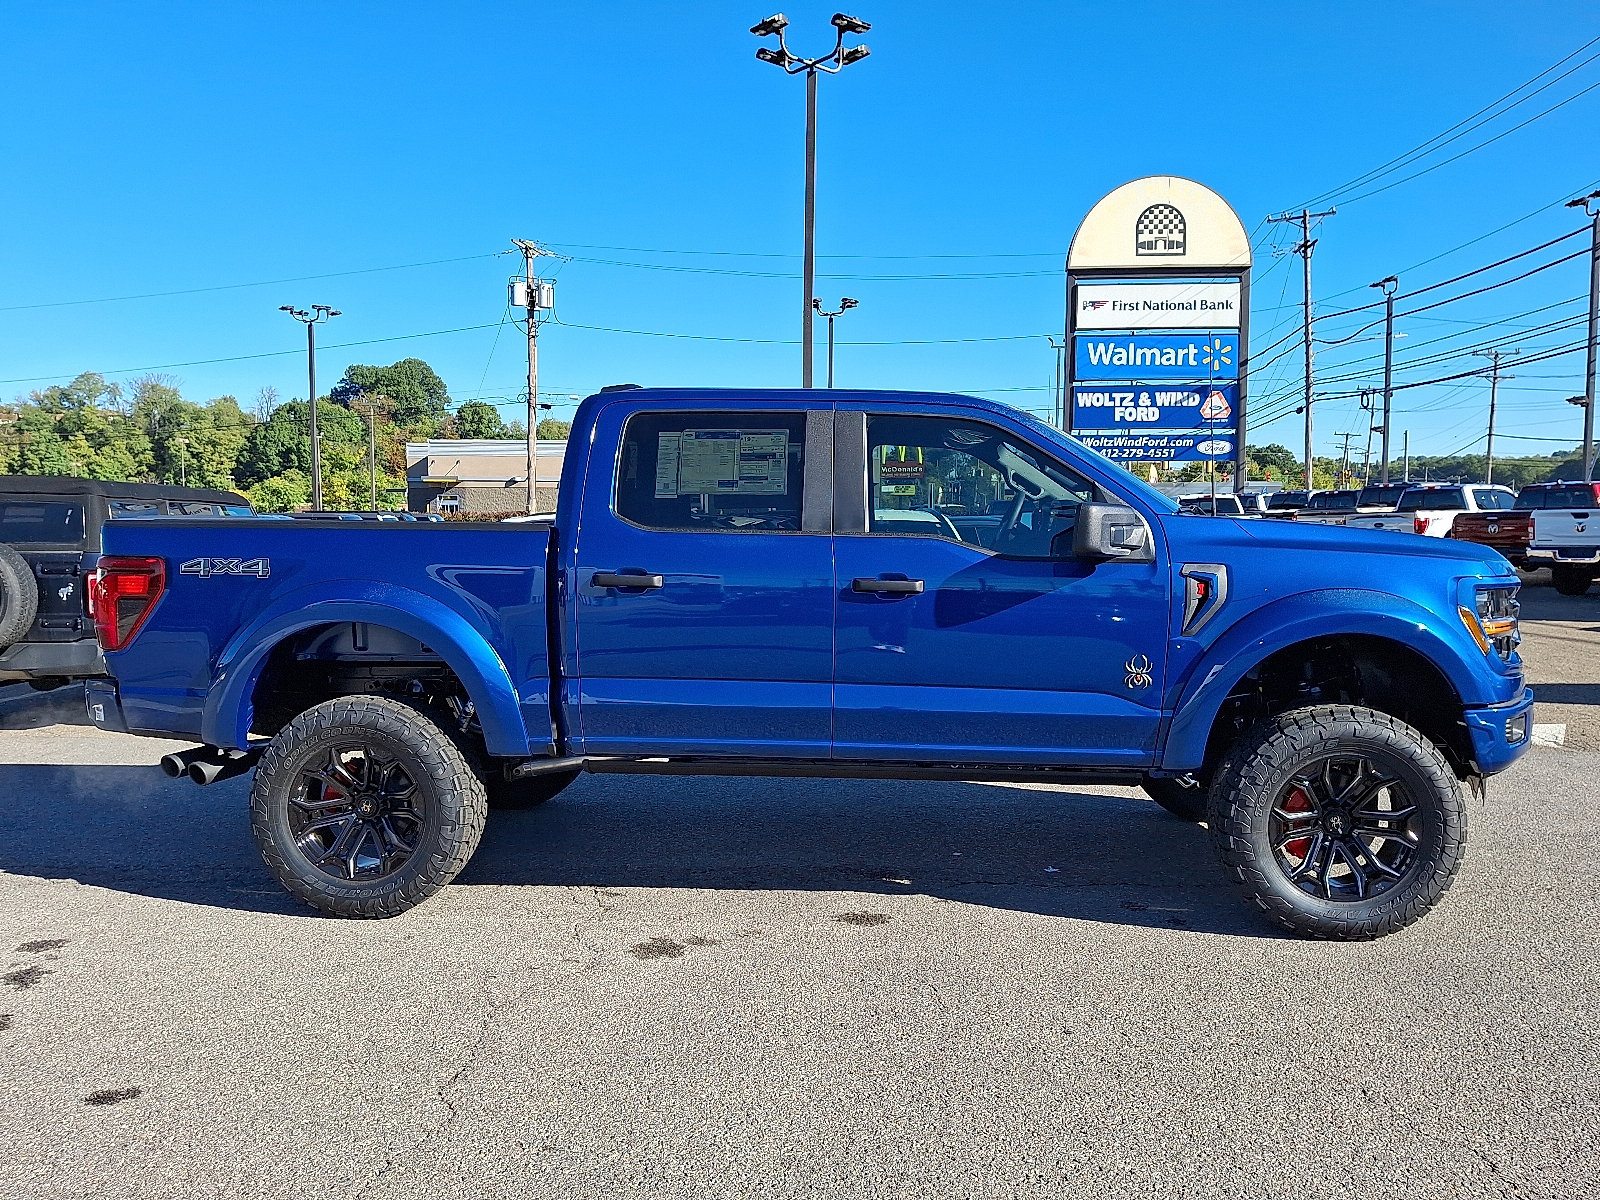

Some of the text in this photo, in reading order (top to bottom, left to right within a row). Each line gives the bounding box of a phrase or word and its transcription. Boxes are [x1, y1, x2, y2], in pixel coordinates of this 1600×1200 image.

[1112, 299, 1234, 311] First National Bank
[1087, 342, 1199, 366] Walmart
[1076, 392, 1135, 408] WOLTZ
[1138, 392, 1152, 407] &
[1154, 391, 1201, 407] WIND
[1114, 406, 1160, 422] FORD
[1082, 436, 1194, 448] WoltzWindFord.com
[1099, 448, 1176, 458] 412-279-4551
